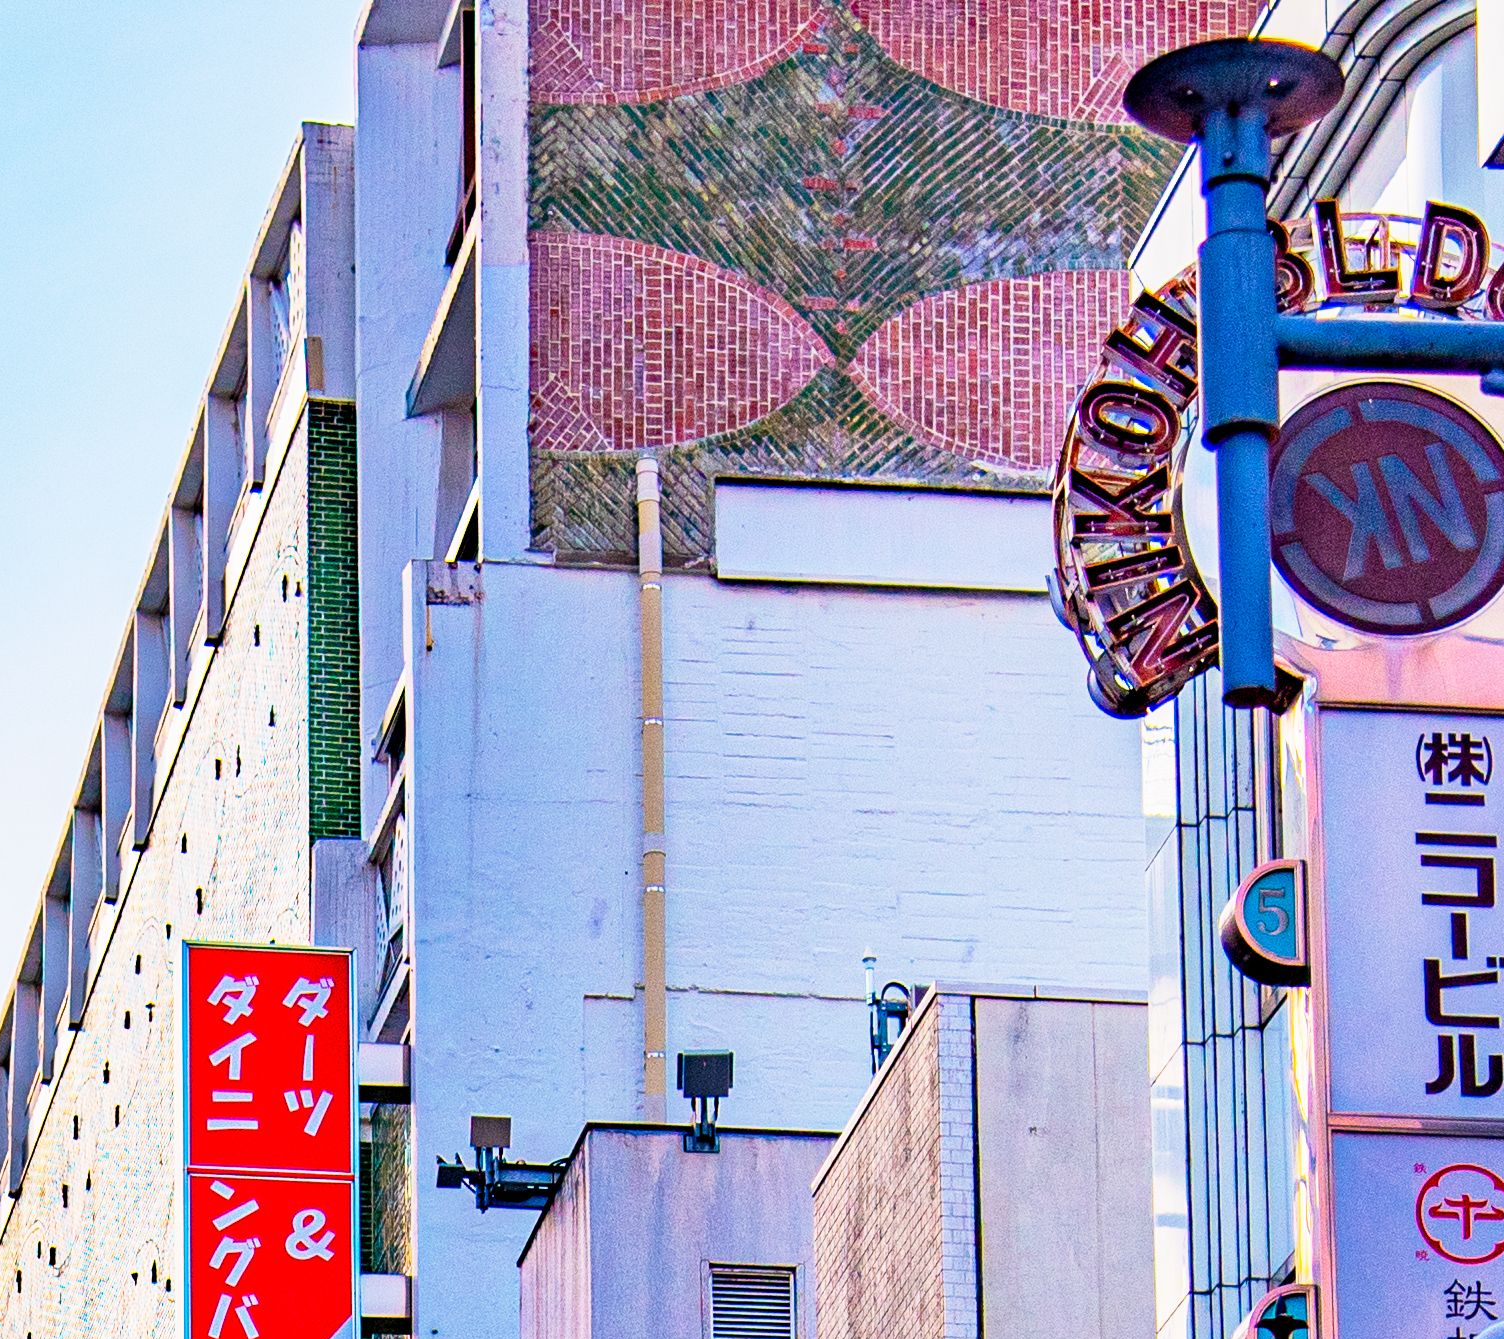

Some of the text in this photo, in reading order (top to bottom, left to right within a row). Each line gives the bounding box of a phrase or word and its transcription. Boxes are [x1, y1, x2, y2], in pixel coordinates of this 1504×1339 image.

[1254, 873, 1289, 936] 5
[283, 976, 335, 1136] ダーツ
[285, 1208, 335, 1261] &
